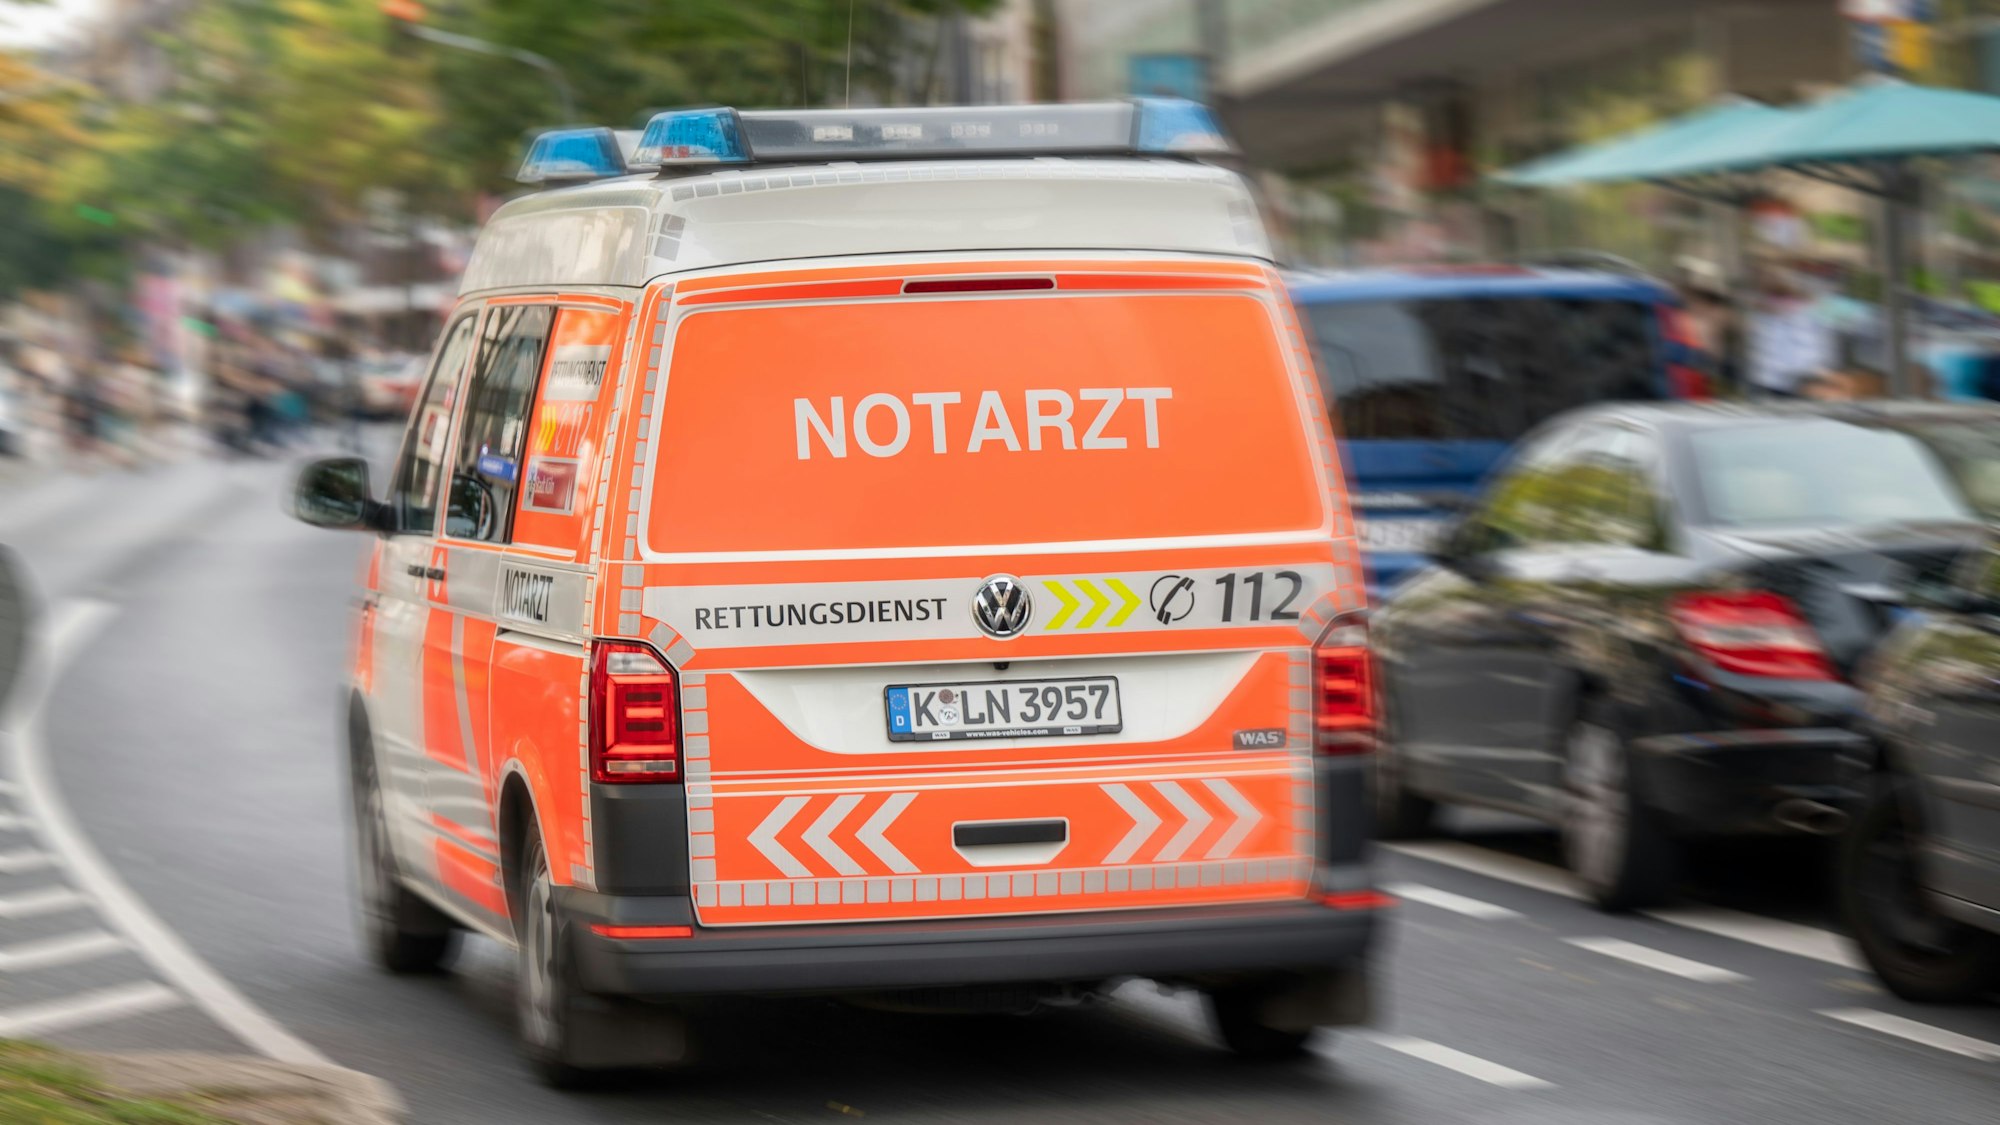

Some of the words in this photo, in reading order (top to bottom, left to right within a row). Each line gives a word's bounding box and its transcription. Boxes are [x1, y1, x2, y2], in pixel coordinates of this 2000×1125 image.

[793, 387, 1173, 460] NOTARZT
[502, 569, 553, 622] NOTARZT
[695, 598, 948, 631] RETTUNGSDIENST
[972, 577, 1031, 637] VW
[1215, 570, 1303, 622] 112
[896, 716, 905, 727] D
[913, 691, 939, 727] K
[960, 688, 1011, 725] LN
[1018, 684, 1110, 723] 3957
[965, 728, 1049, 738] www.was-vehicles.com
[1239, 731, 1279, 746] WAS
